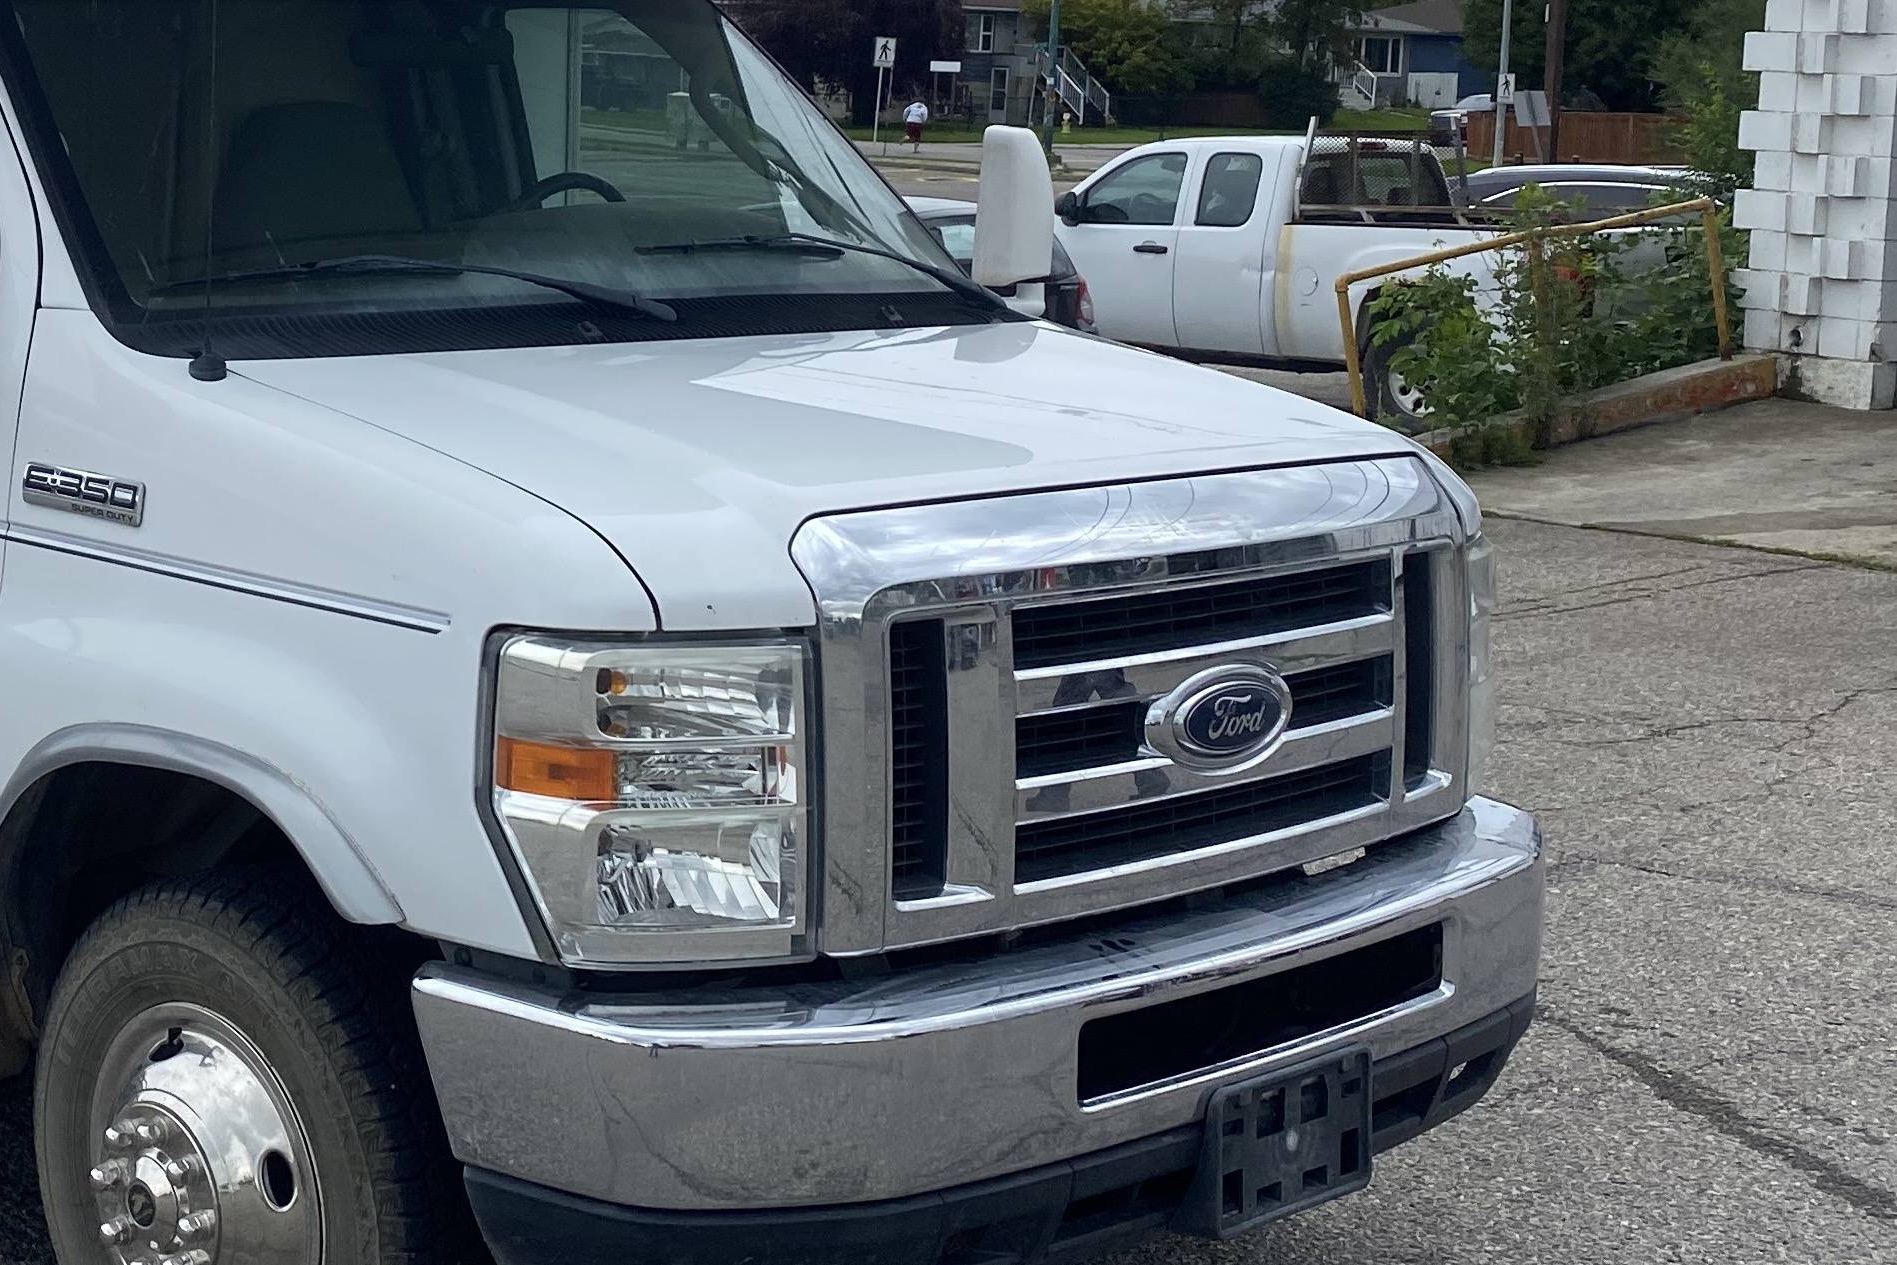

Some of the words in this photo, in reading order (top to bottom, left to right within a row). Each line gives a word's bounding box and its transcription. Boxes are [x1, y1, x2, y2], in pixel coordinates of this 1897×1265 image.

[70, 502, 105, 517] SUPER
[106, 509, 135, 524] DUTY
[1208, 694, 1266, 740] Ford
